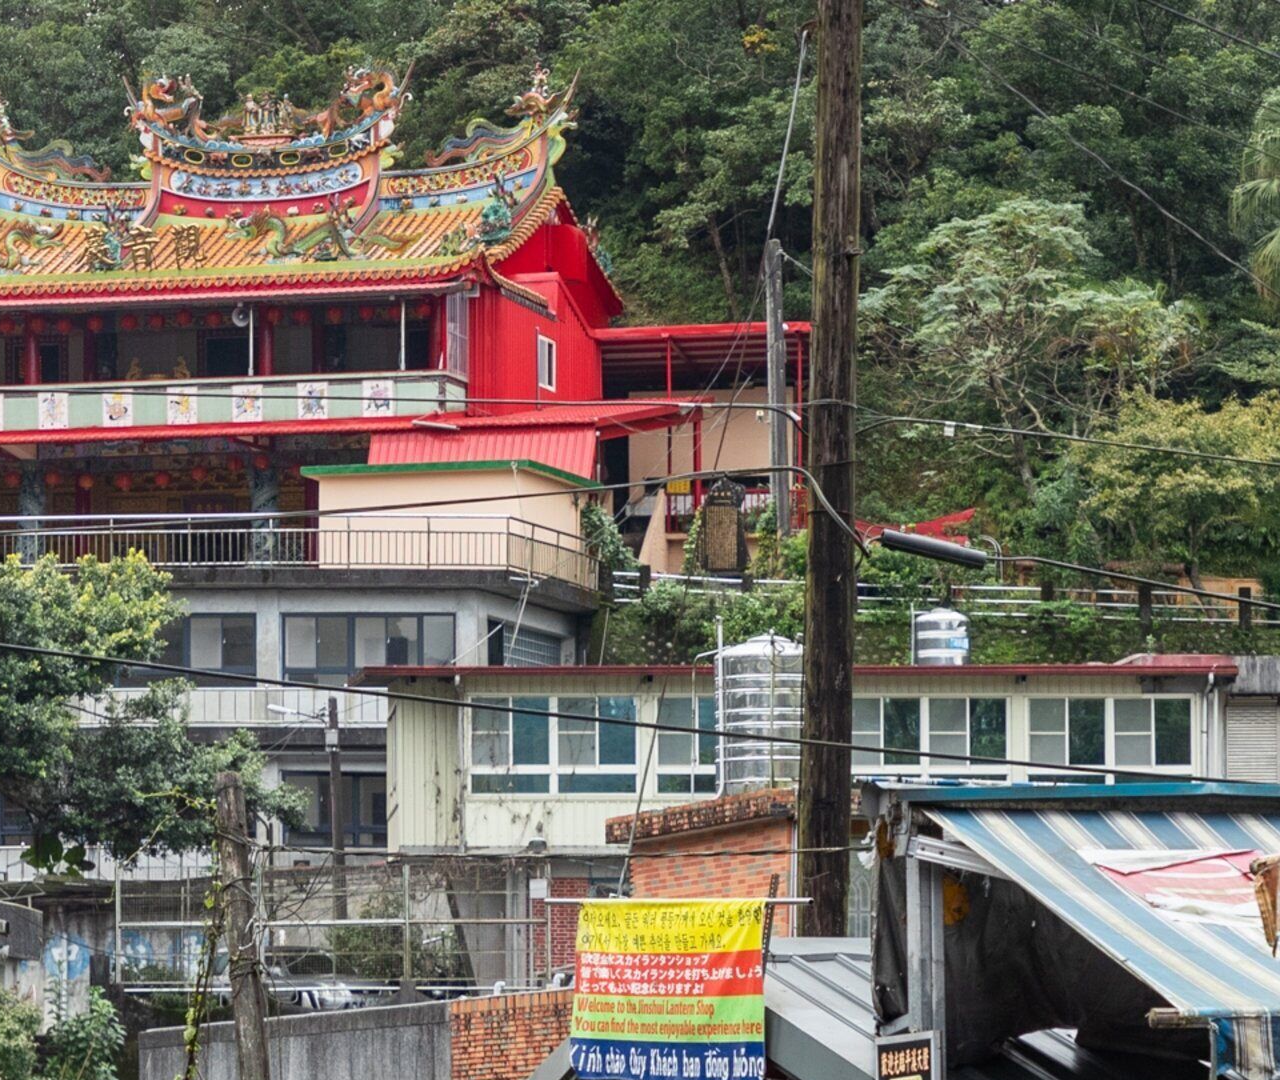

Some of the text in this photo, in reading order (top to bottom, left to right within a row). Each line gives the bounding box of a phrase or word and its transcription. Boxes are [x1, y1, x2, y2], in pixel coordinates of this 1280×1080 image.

[577, 997, 615, 1013] Welcome
[617, 1000, 625, 1013] to
[626, 999, 637, 1014] the
[666, 1000, 694, 1015] Lantern
[696, 999, 715, 1019] Shop
[575, 1016, 595, 1032] You
[597, 1020, 609, 1032] can
[610, 1017, 625, 1032] find
[627, 1019, 639, 1033] the
[640, 1021, 658, 1034] most
[659, 1019, 696, 1038] enjoyable
[697, 1019, 740, 1038] experience
